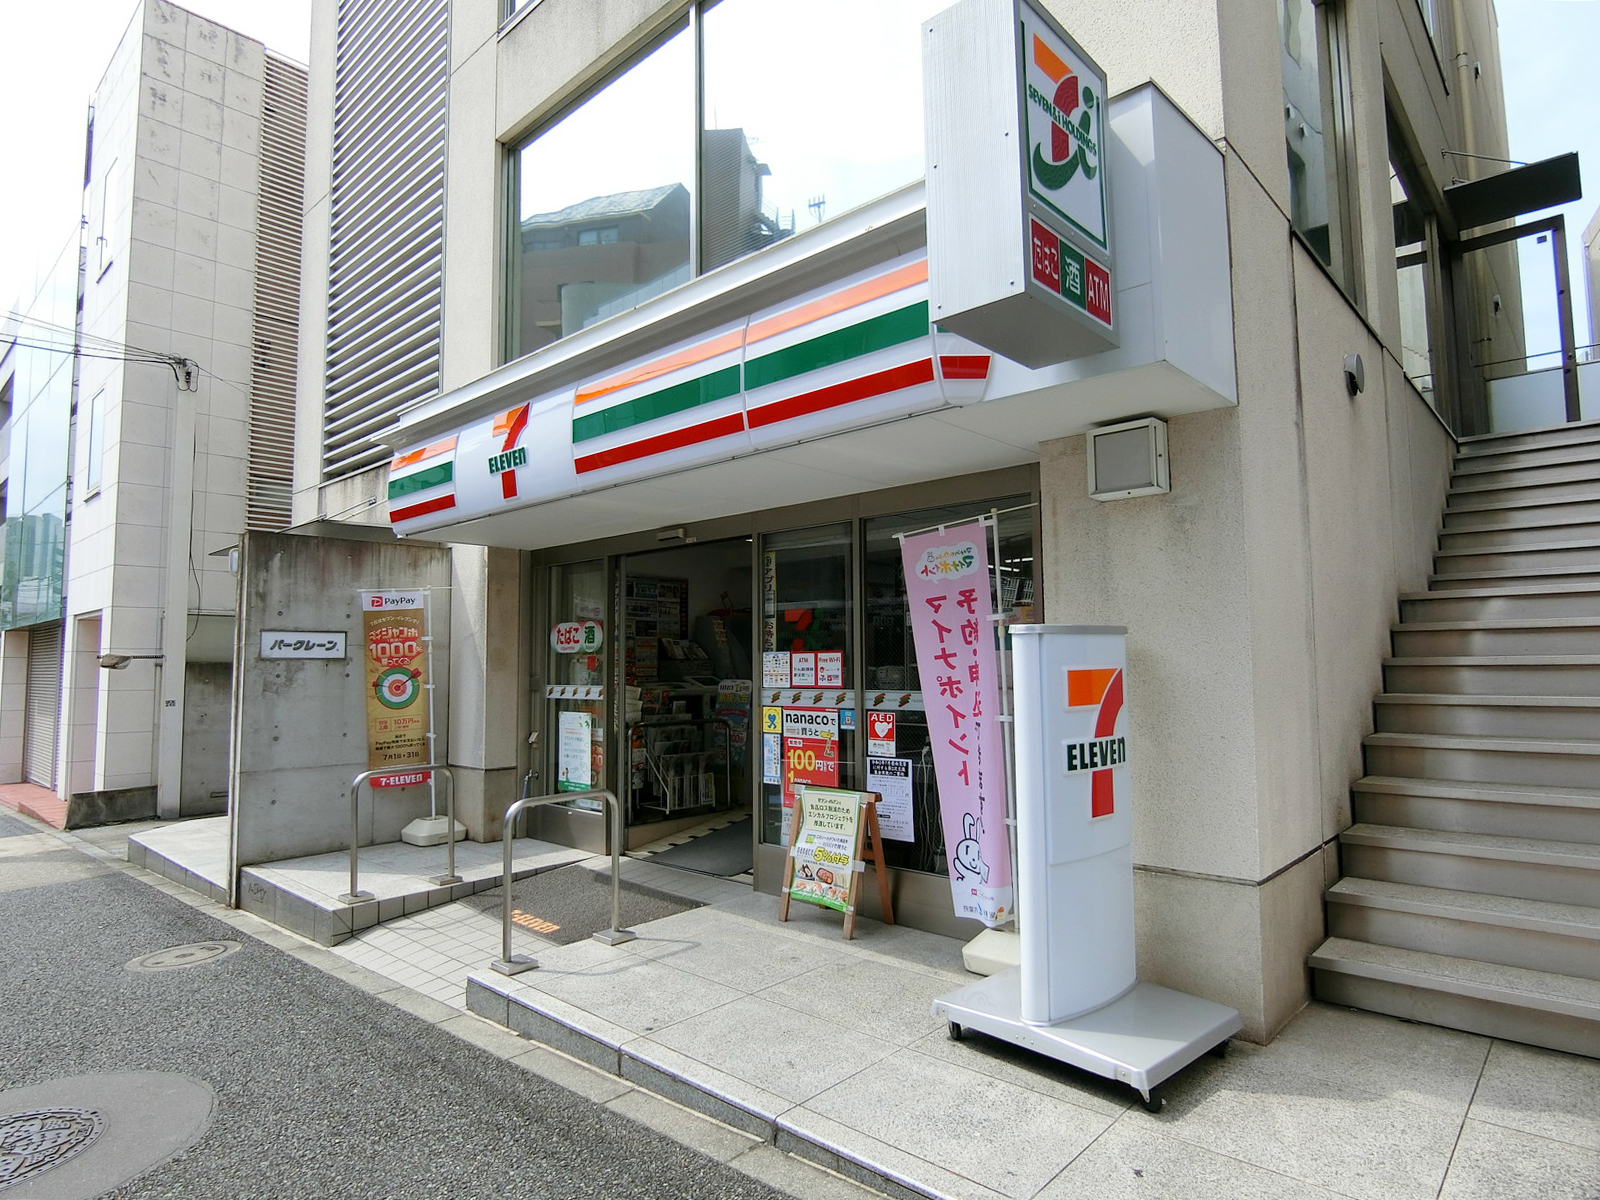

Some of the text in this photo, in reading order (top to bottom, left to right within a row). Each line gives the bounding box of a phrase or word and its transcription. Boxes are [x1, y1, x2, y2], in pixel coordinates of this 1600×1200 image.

[1065, 255, 1080, 295] 酒
[1088, 272, 1109, 313] ATM
[384, 596, 416, 606] PayPay
[556, 625, 596, 645] たばこ 酒
[870, 713, 894, 721] AED
[801, 727, 819, 737] 買うと
